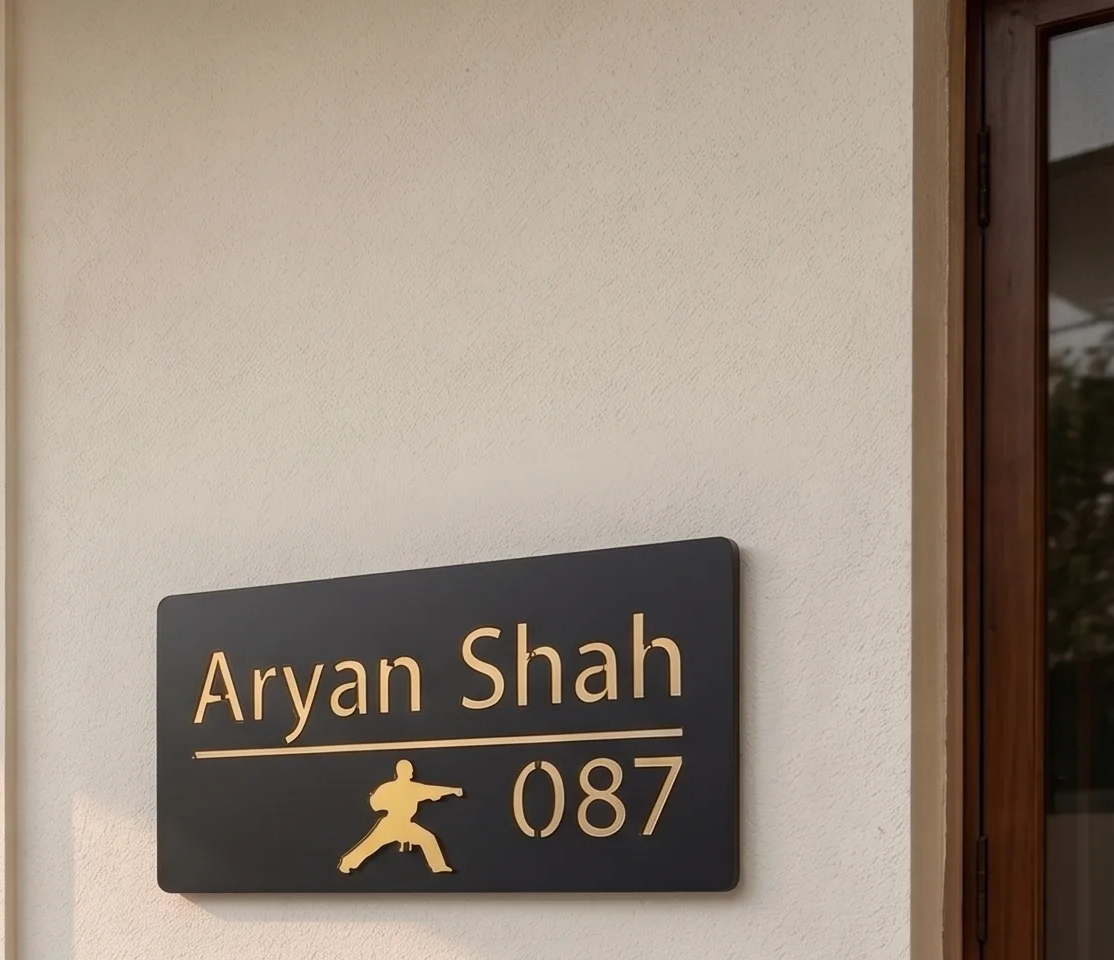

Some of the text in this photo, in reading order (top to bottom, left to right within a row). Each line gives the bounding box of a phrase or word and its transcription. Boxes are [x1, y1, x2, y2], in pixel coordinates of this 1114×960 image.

[193, 612, 682, 744] Aryan Shah
[512, 756, 683, 837] 087
